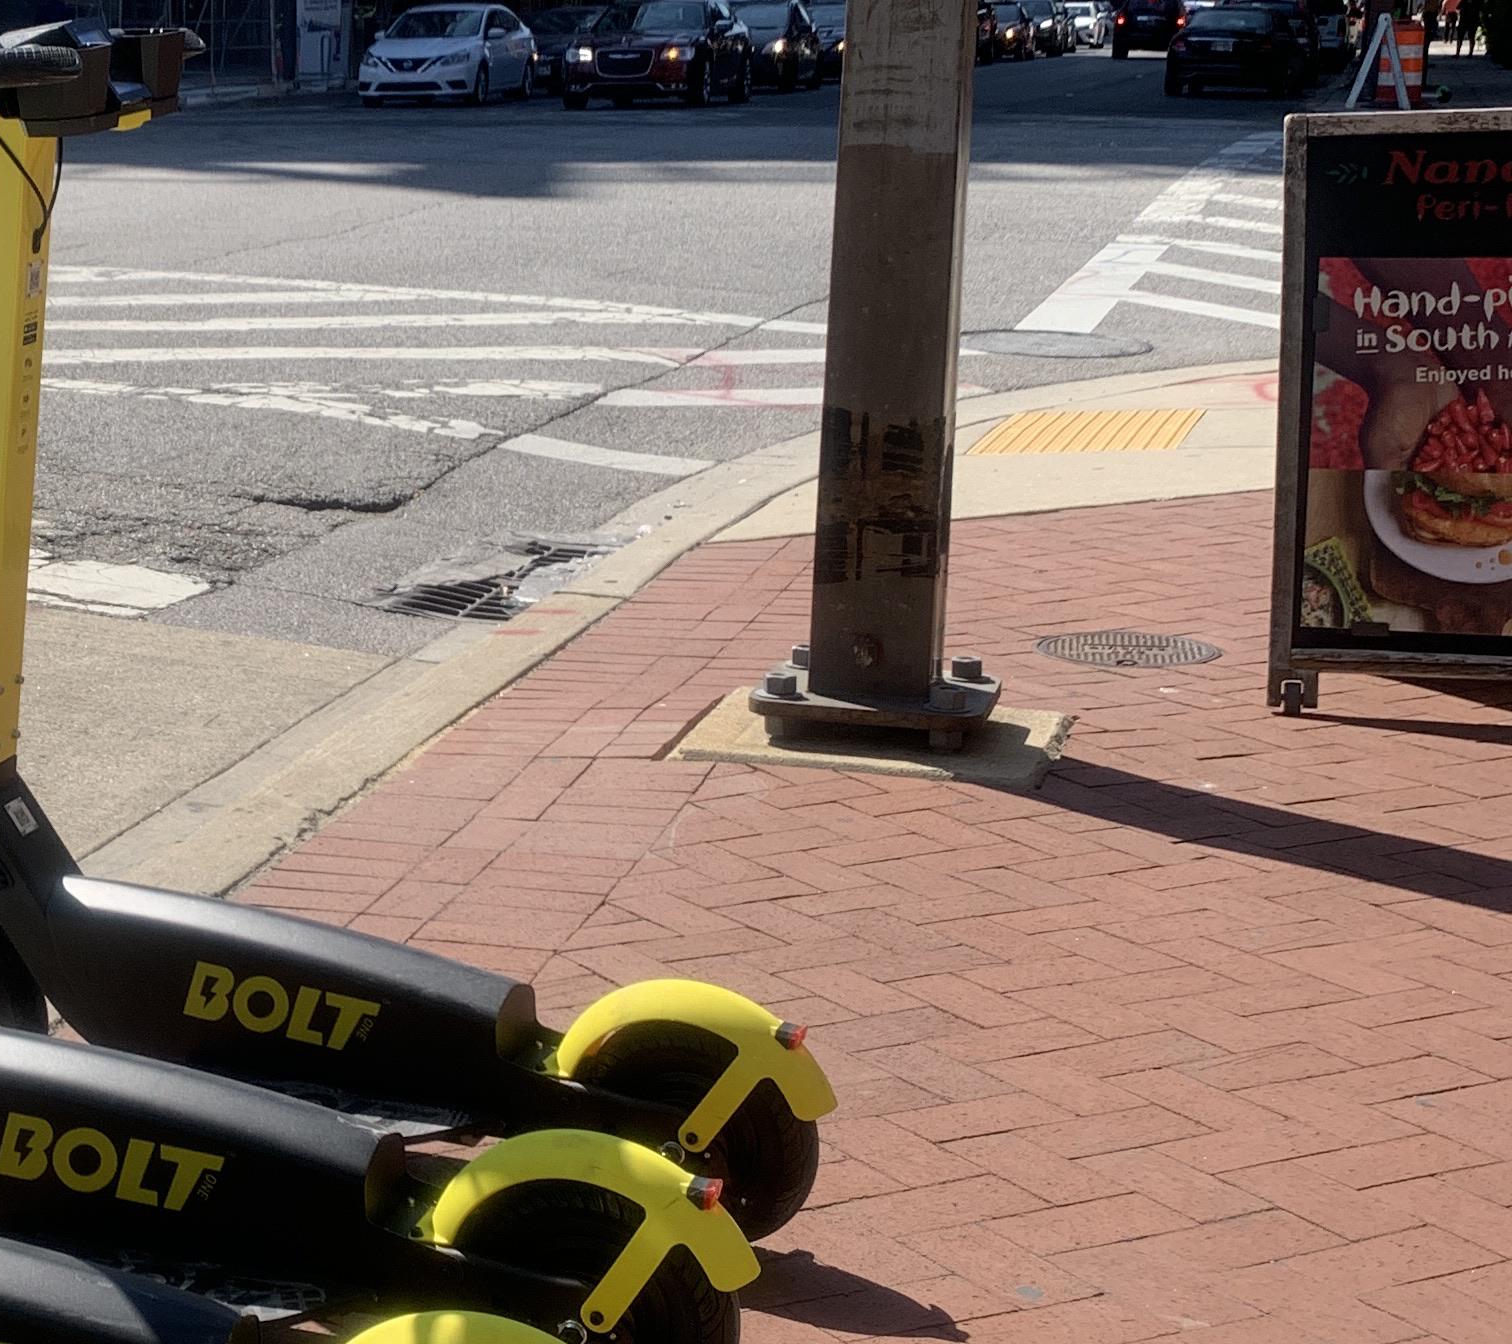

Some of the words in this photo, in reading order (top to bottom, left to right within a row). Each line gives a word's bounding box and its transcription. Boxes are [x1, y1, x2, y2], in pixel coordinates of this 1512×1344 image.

[1356, 329, 1377, 348] in
[1385, 321, 1500, 353] South
[1416, 365, 1491, 384] Enjoyed
[183, 960, 382, 1050] BOLT
